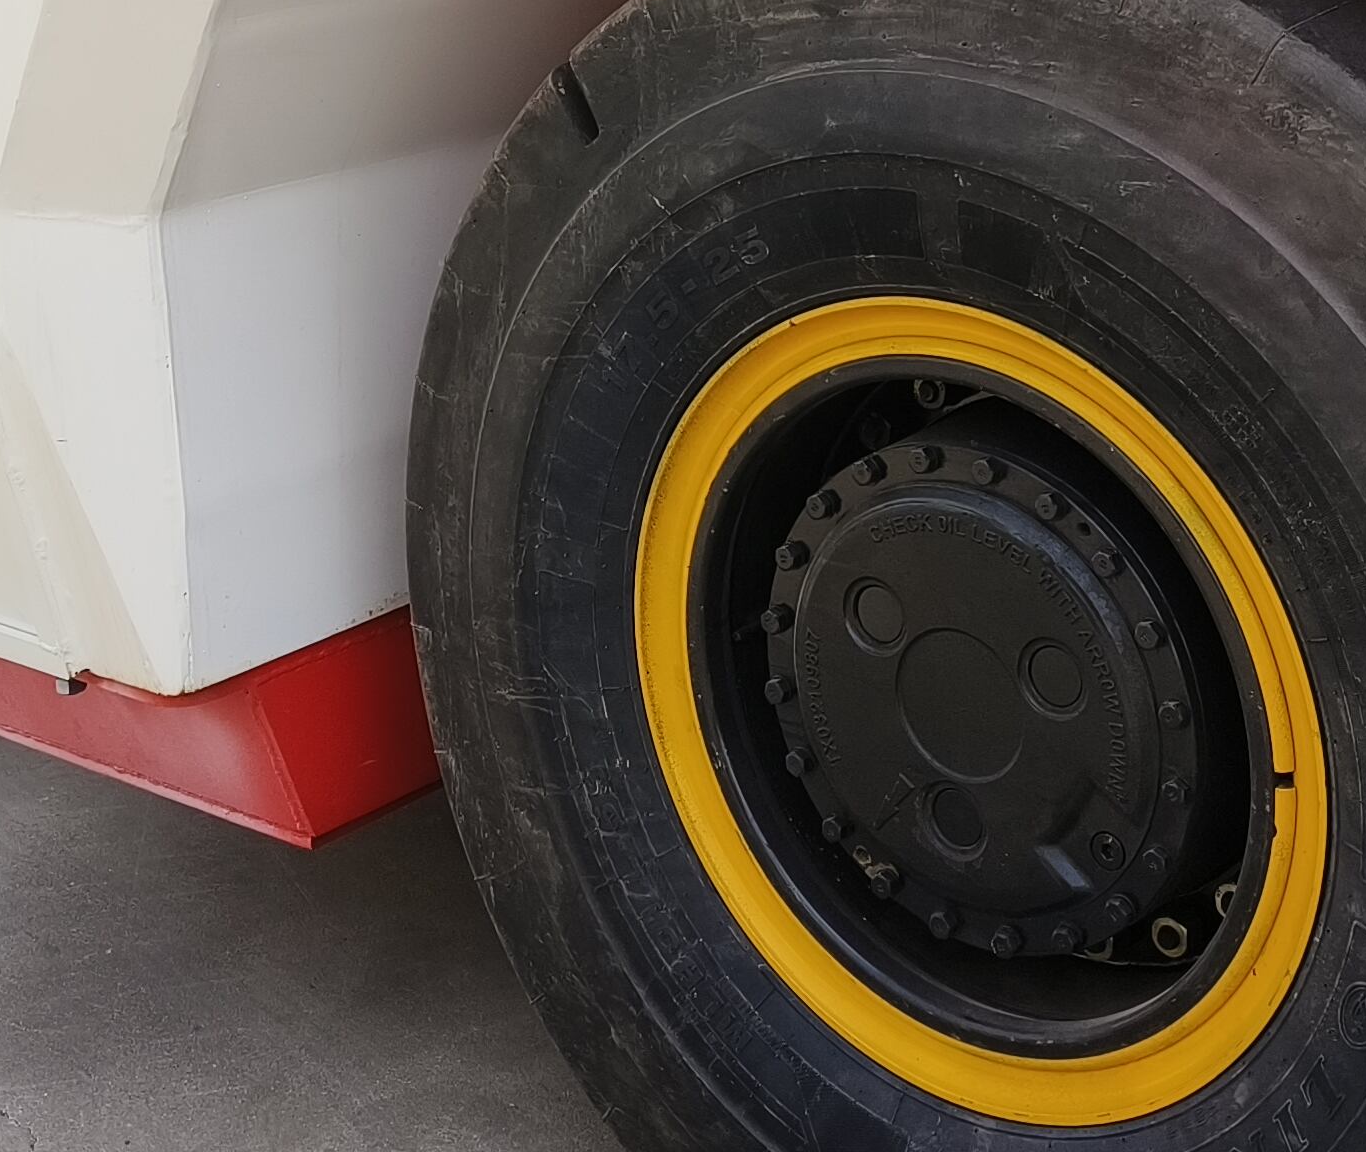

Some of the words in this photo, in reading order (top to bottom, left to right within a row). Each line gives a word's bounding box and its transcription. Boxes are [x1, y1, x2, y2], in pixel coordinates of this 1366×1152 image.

[869, 512, 934, 545] CHECK
[936, 514, 967, 537] OIL
[971, 523, 1033, 575] LEVEL
[1037, 568, 1084, 626] WITH
[1076, 629, 1123, 717] ARROW
